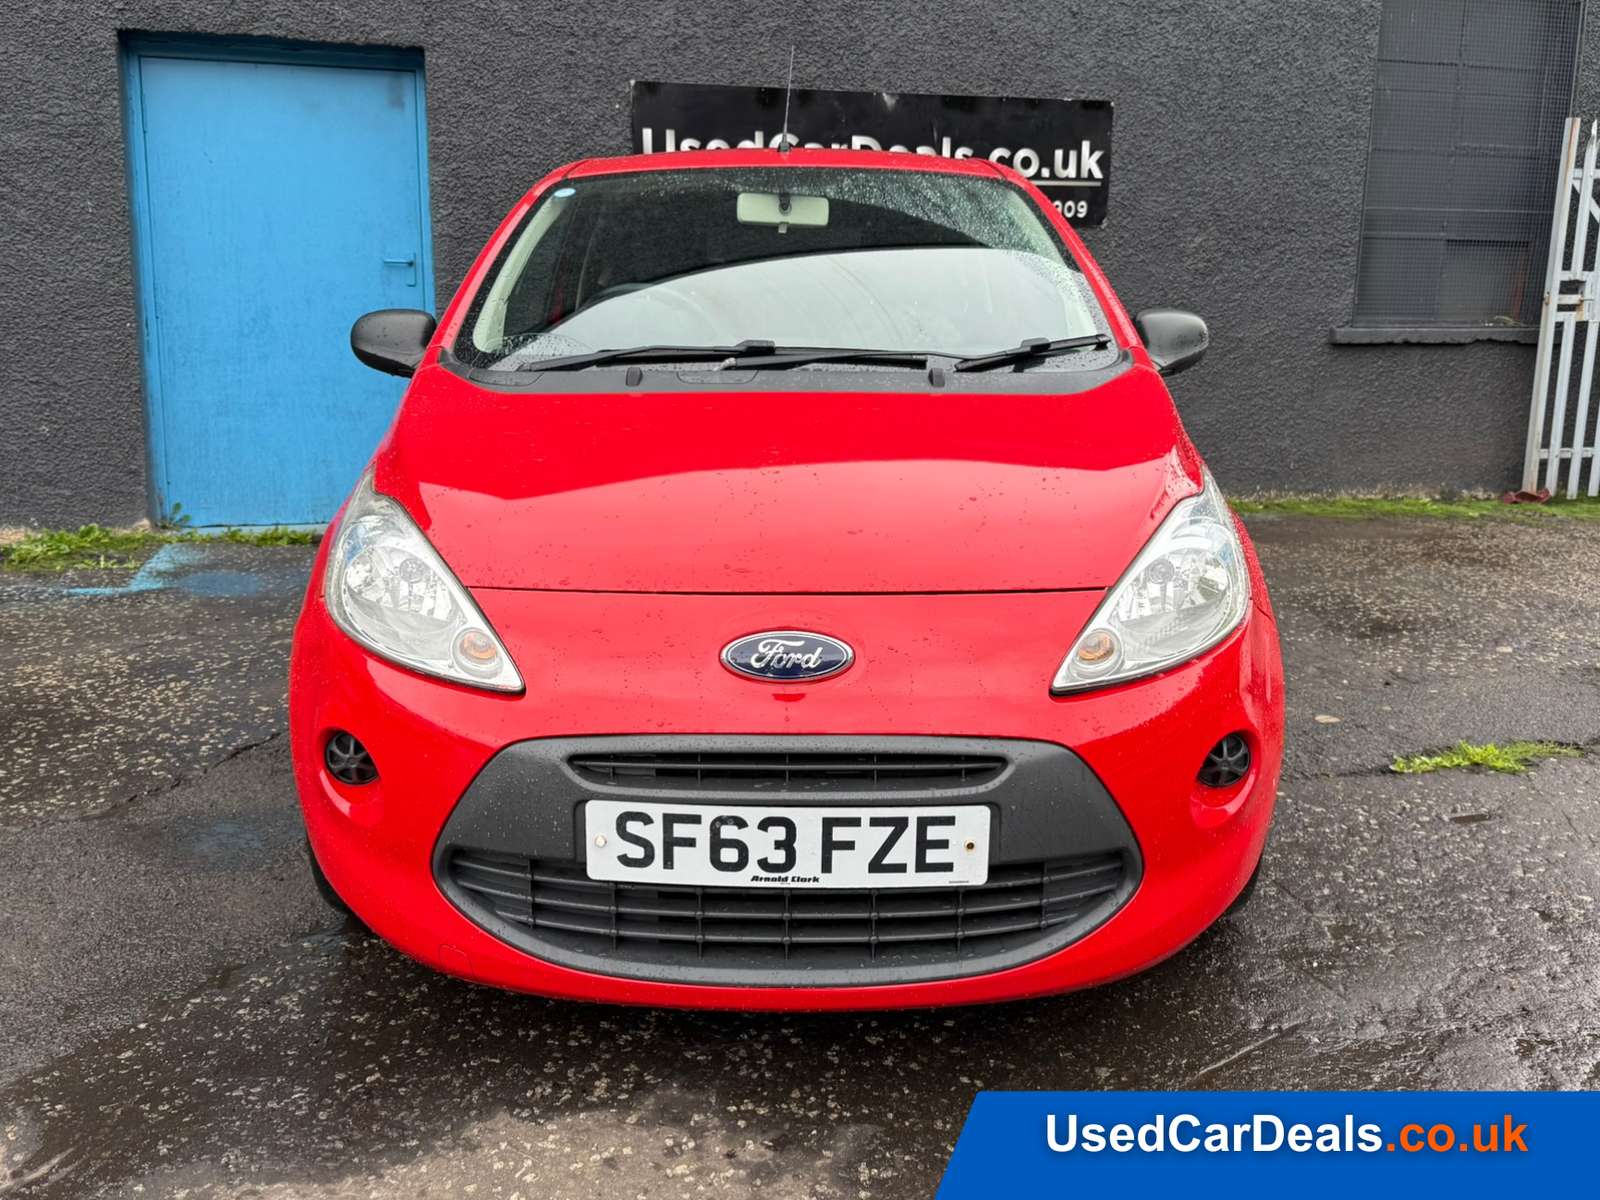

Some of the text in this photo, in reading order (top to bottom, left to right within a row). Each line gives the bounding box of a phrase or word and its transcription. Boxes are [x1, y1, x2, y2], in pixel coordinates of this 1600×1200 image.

[751, 639, 823, 669] Ford
[616, 811, 956, 874] SF63 FZE
[750, 875, 789, 883] Arnold
